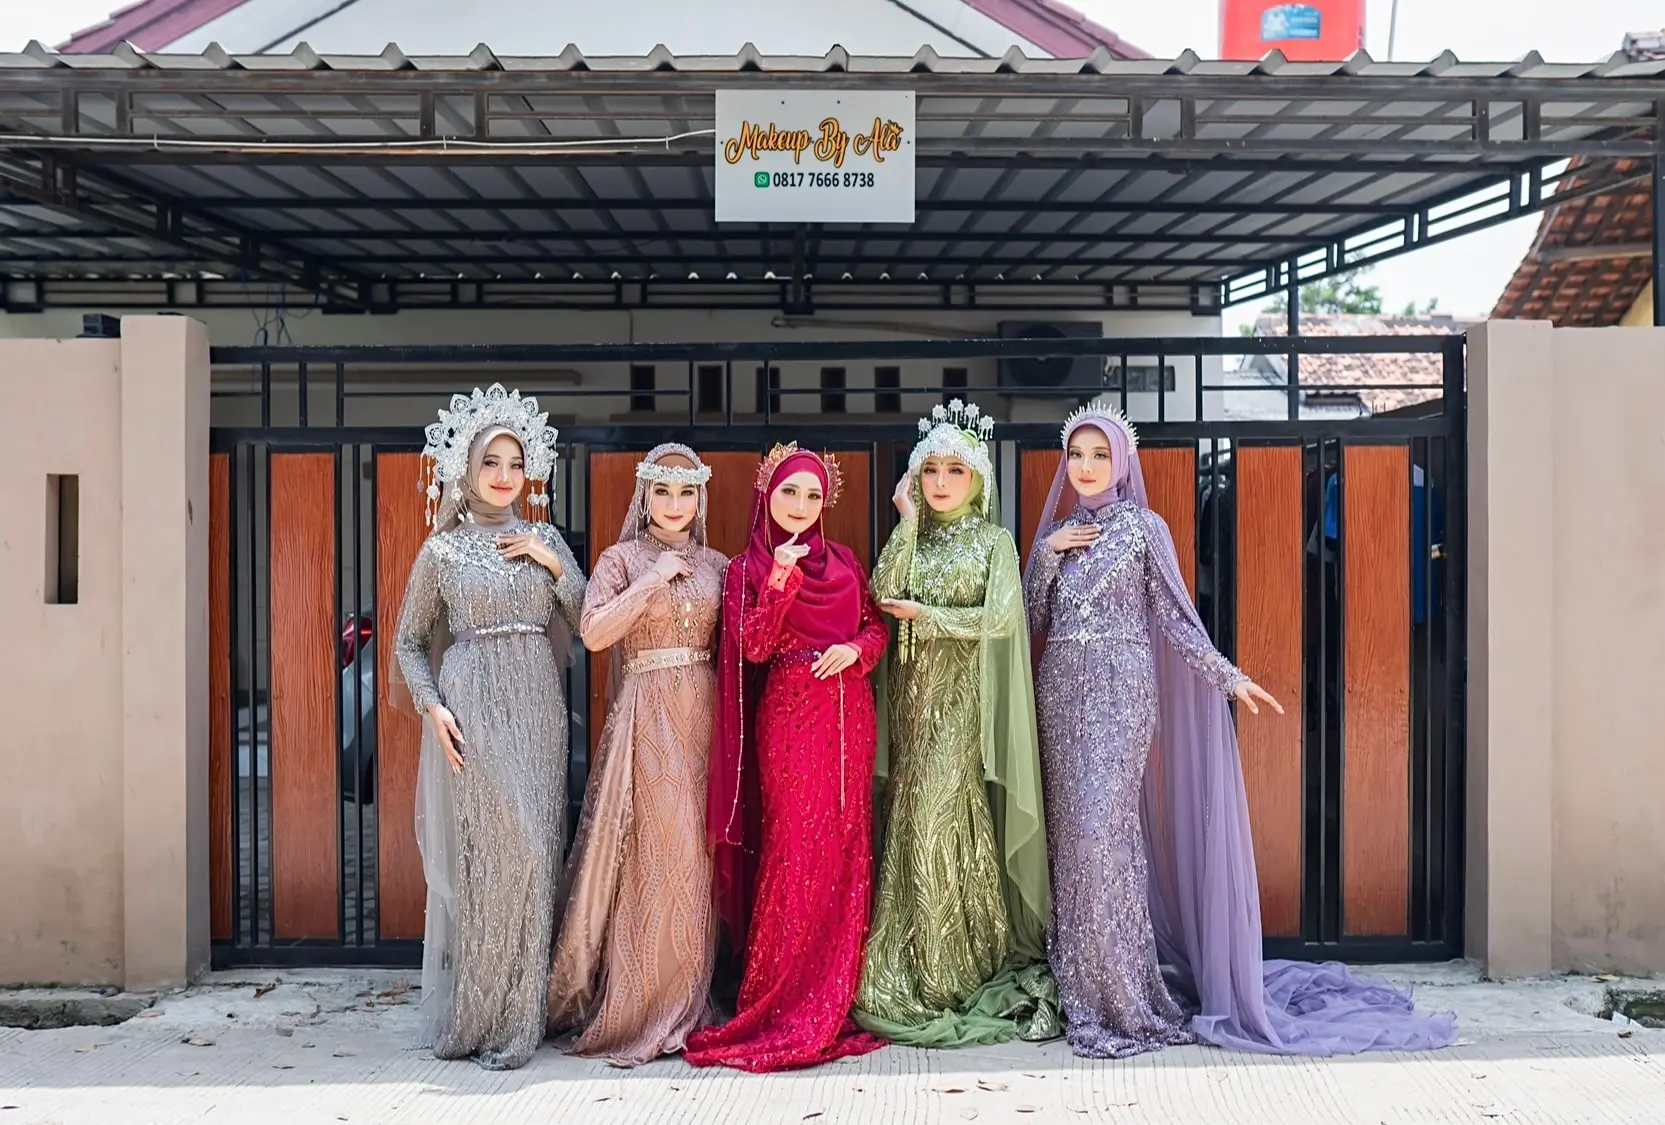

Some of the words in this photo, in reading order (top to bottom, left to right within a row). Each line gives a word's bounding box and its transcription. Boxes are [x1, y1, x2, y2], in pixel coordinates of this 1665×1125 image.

[725, 120, 812, 164] Makeup
[814, 117, 849, 168] By
[853, 117, 901, 162] Ala
[773, 172, 804, 187] 0817
[808, 172, 839, 187] 7666
[843, 172, 875, 187] 8738
